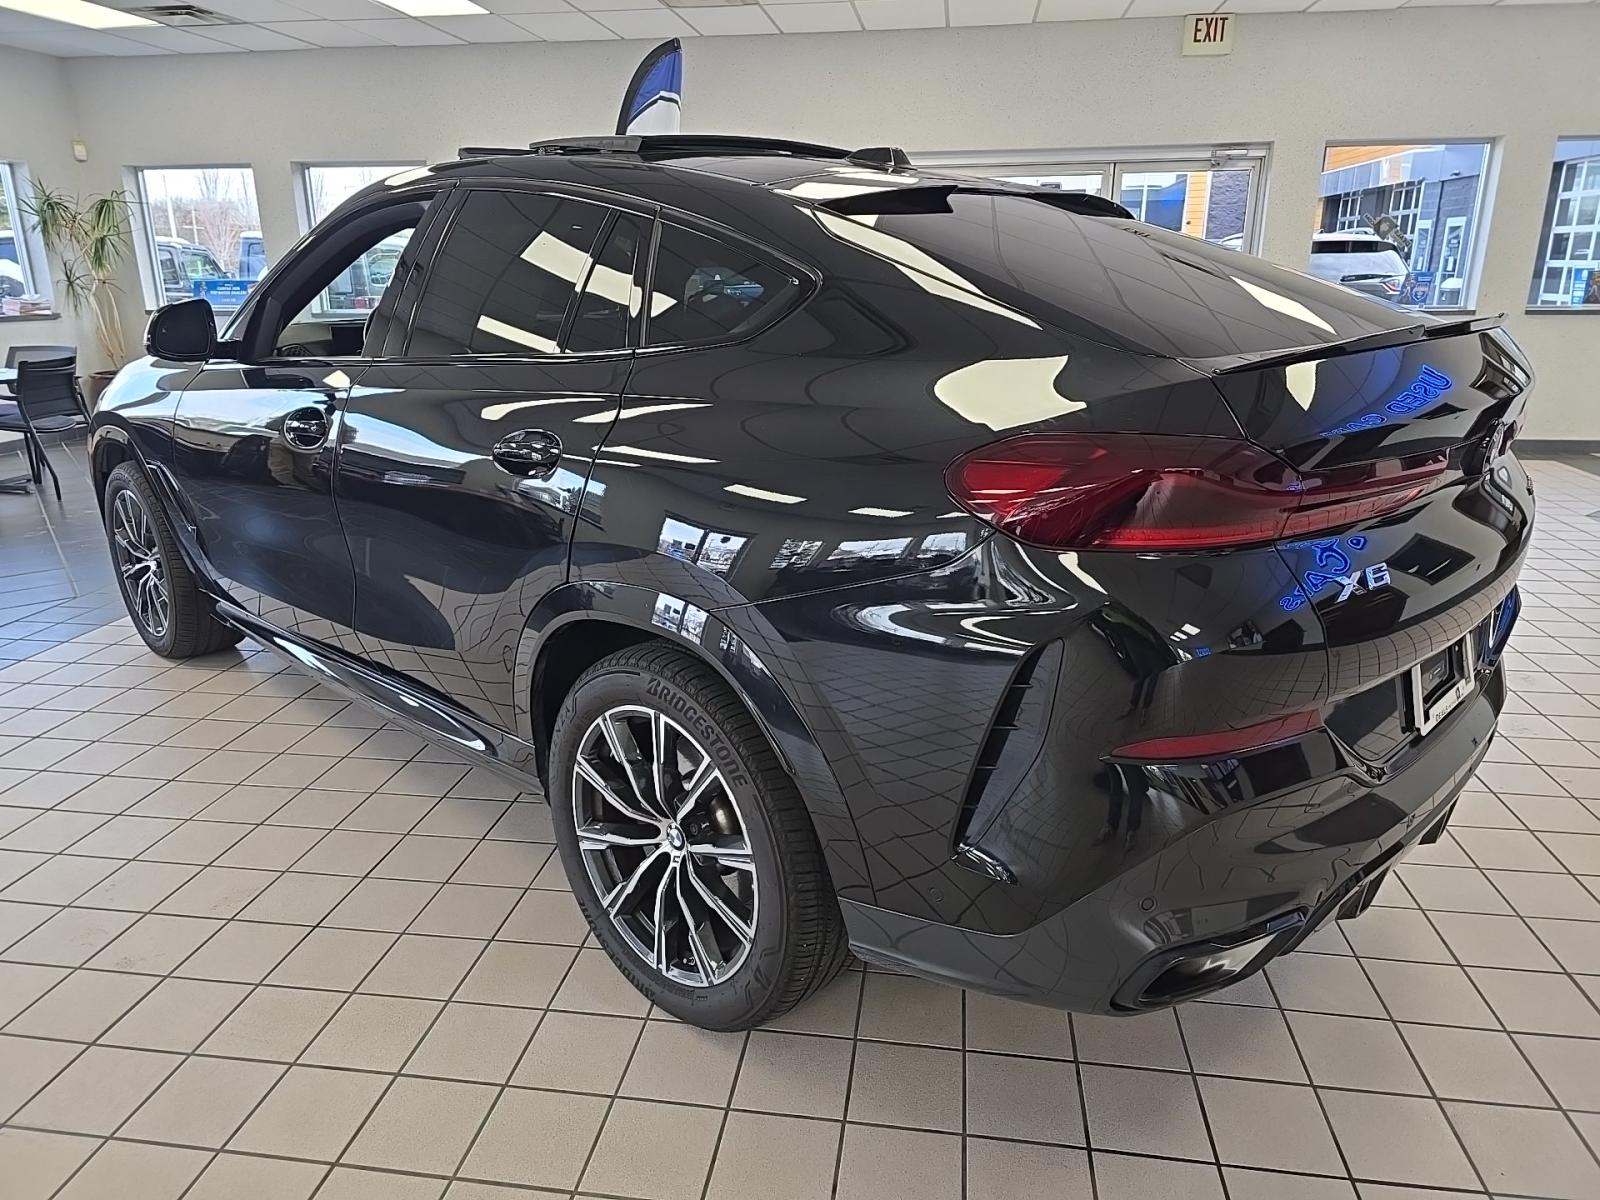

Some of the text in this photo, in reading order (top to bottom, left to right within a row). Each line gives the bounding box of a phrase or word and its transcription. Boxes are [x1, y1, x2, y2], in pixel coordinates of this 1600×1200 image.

[1193, 16, 1229, 44] EXIT
[1334, 562, 1391, 603] X6
[645, 676, 752, 788] BRIDGESTONE
